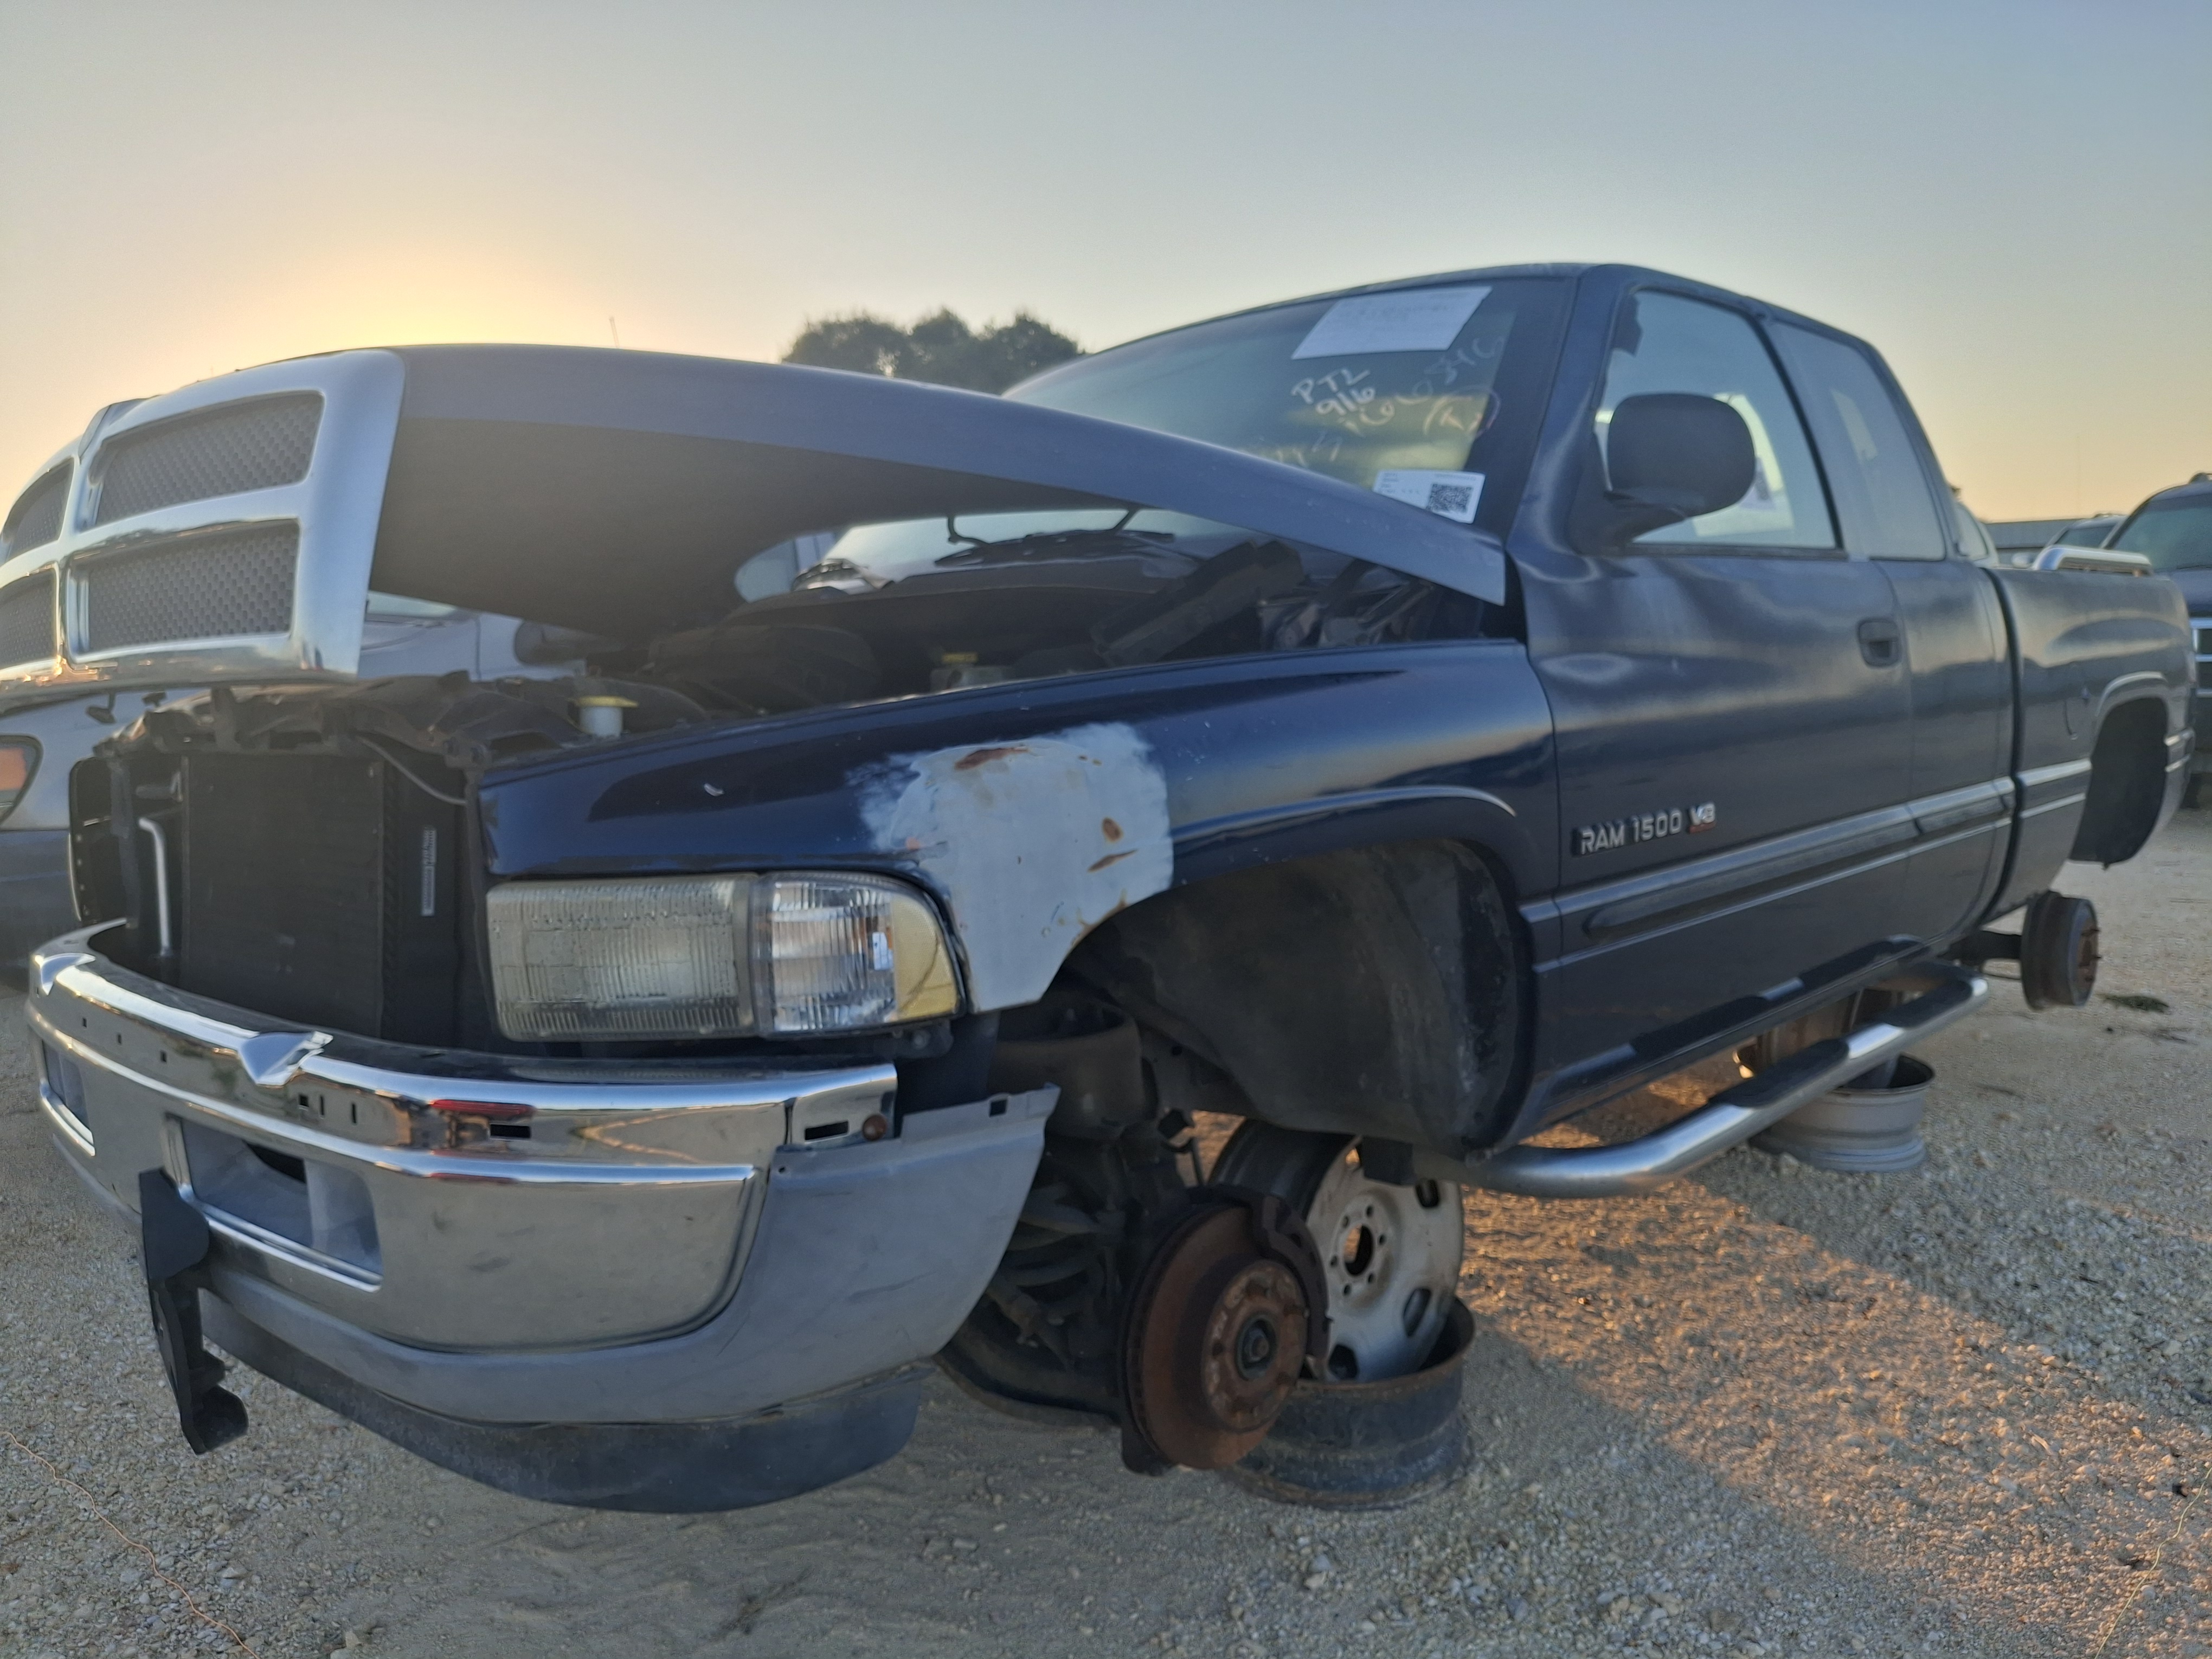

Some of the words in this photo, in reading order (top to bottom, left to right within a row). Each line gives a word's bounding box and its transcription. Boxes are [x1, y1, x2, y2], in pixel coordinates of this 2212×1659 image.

[1580, 821, 1625, 855] RAM
[1632, 810, 1682, 843] 1500
[1688, 802, 1716, 826] V8
